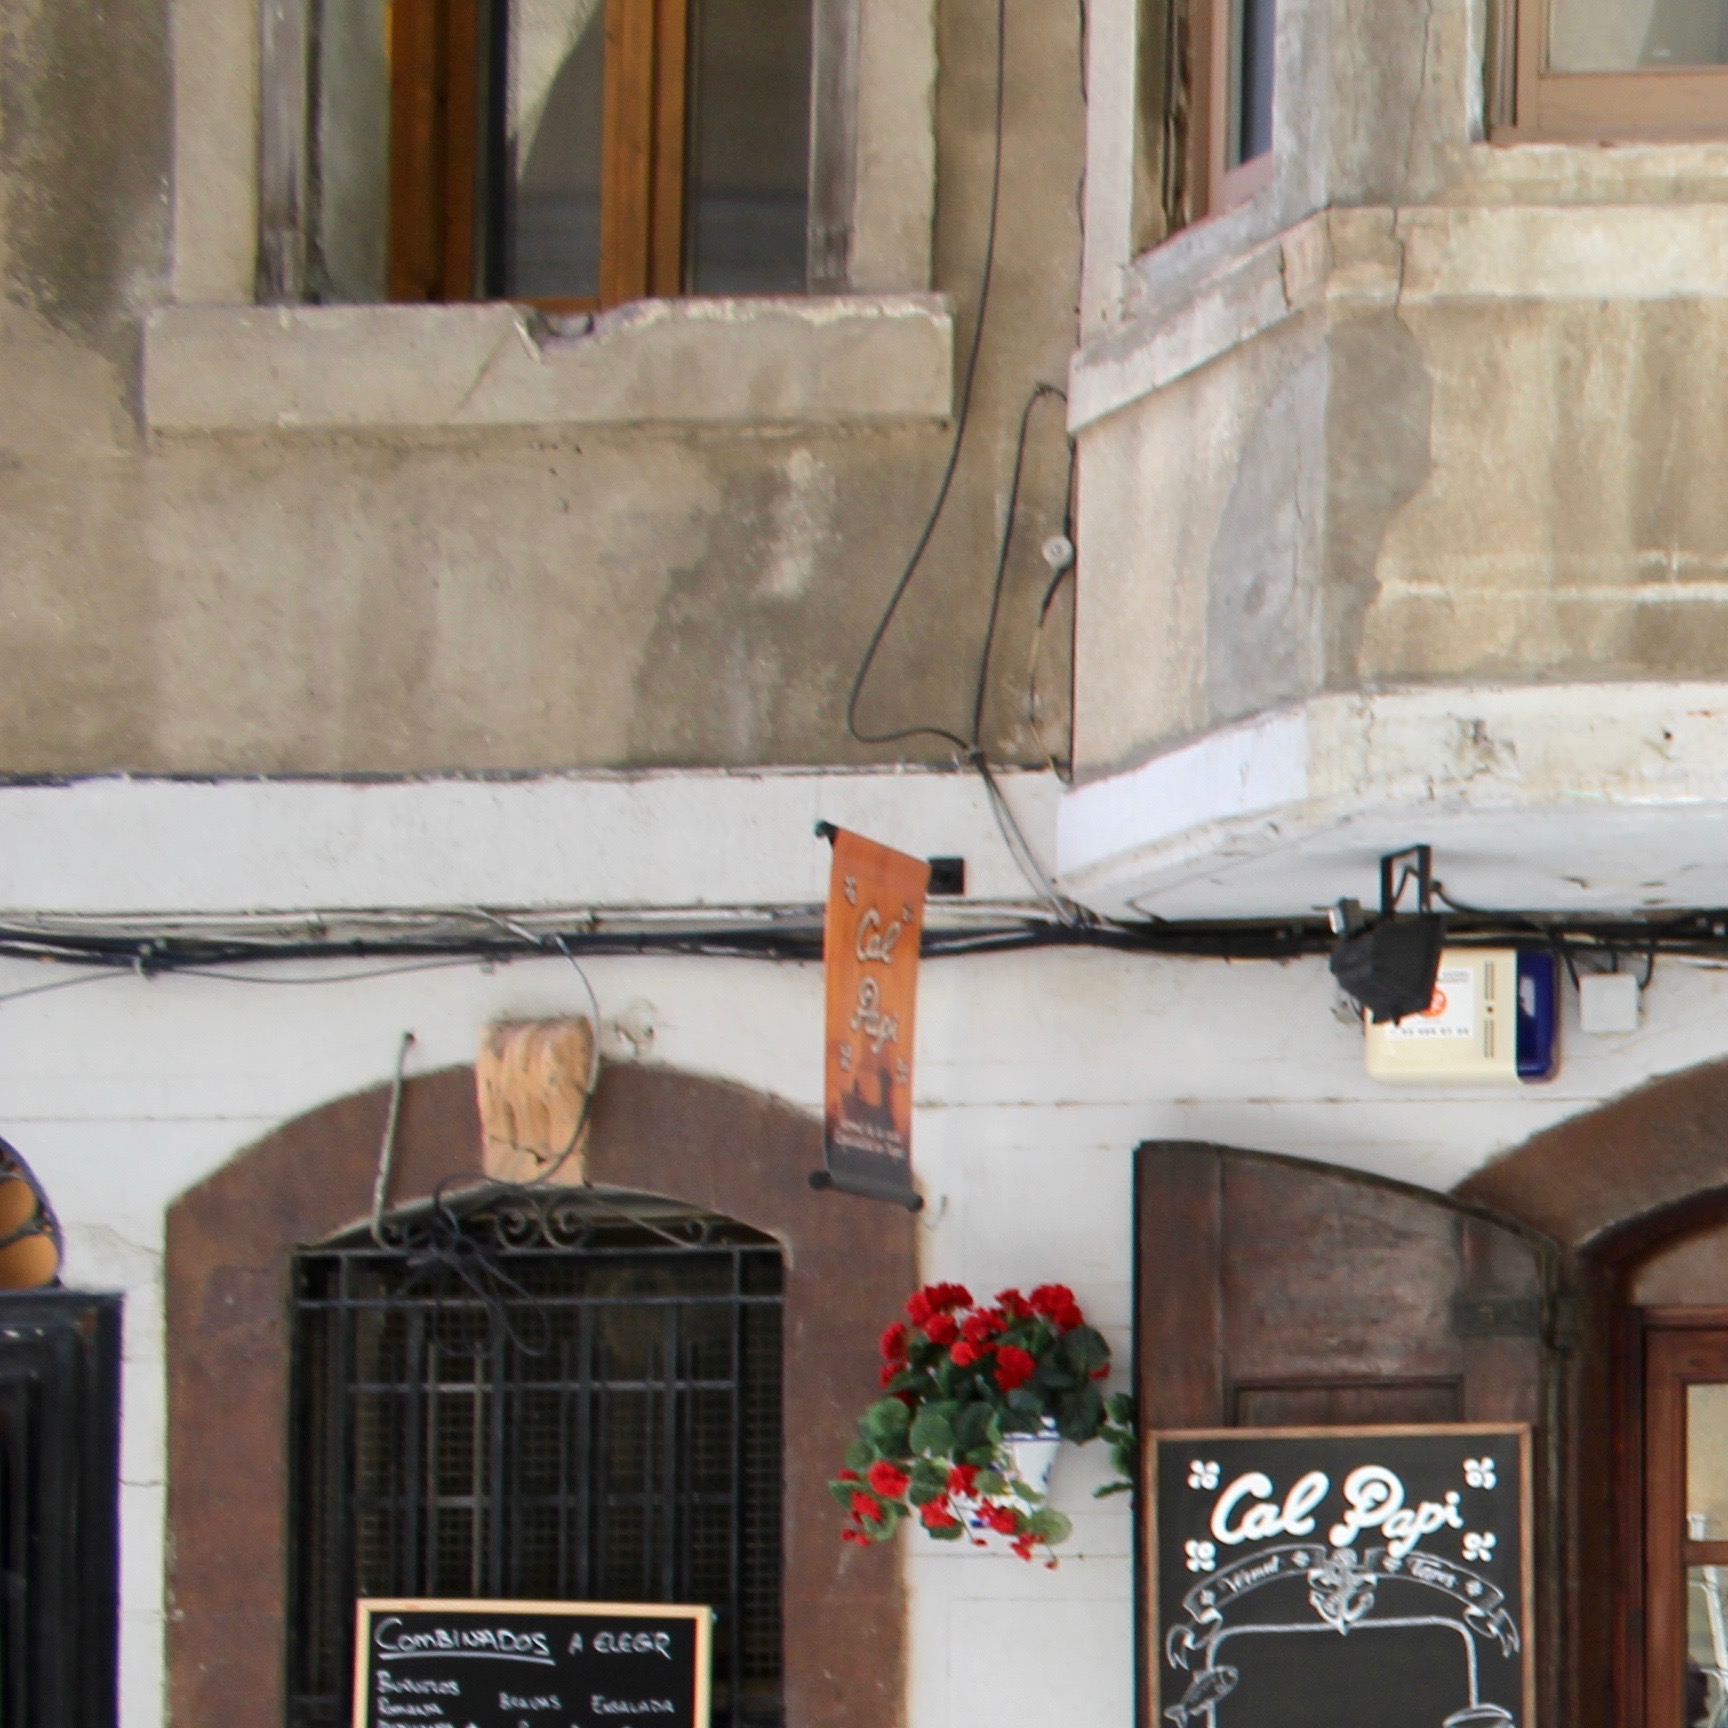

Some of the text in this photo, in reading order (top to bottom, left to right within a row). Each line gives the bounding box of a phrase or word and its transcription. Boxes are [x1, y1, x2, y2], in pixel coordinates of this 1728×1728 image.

[857, 908, 901, 963] Cal
[850, 976, 899, 1054] Papi
[1210, 1465, 1464, 1556] Cal Papi
[568, 1633, 584, 1656] A
